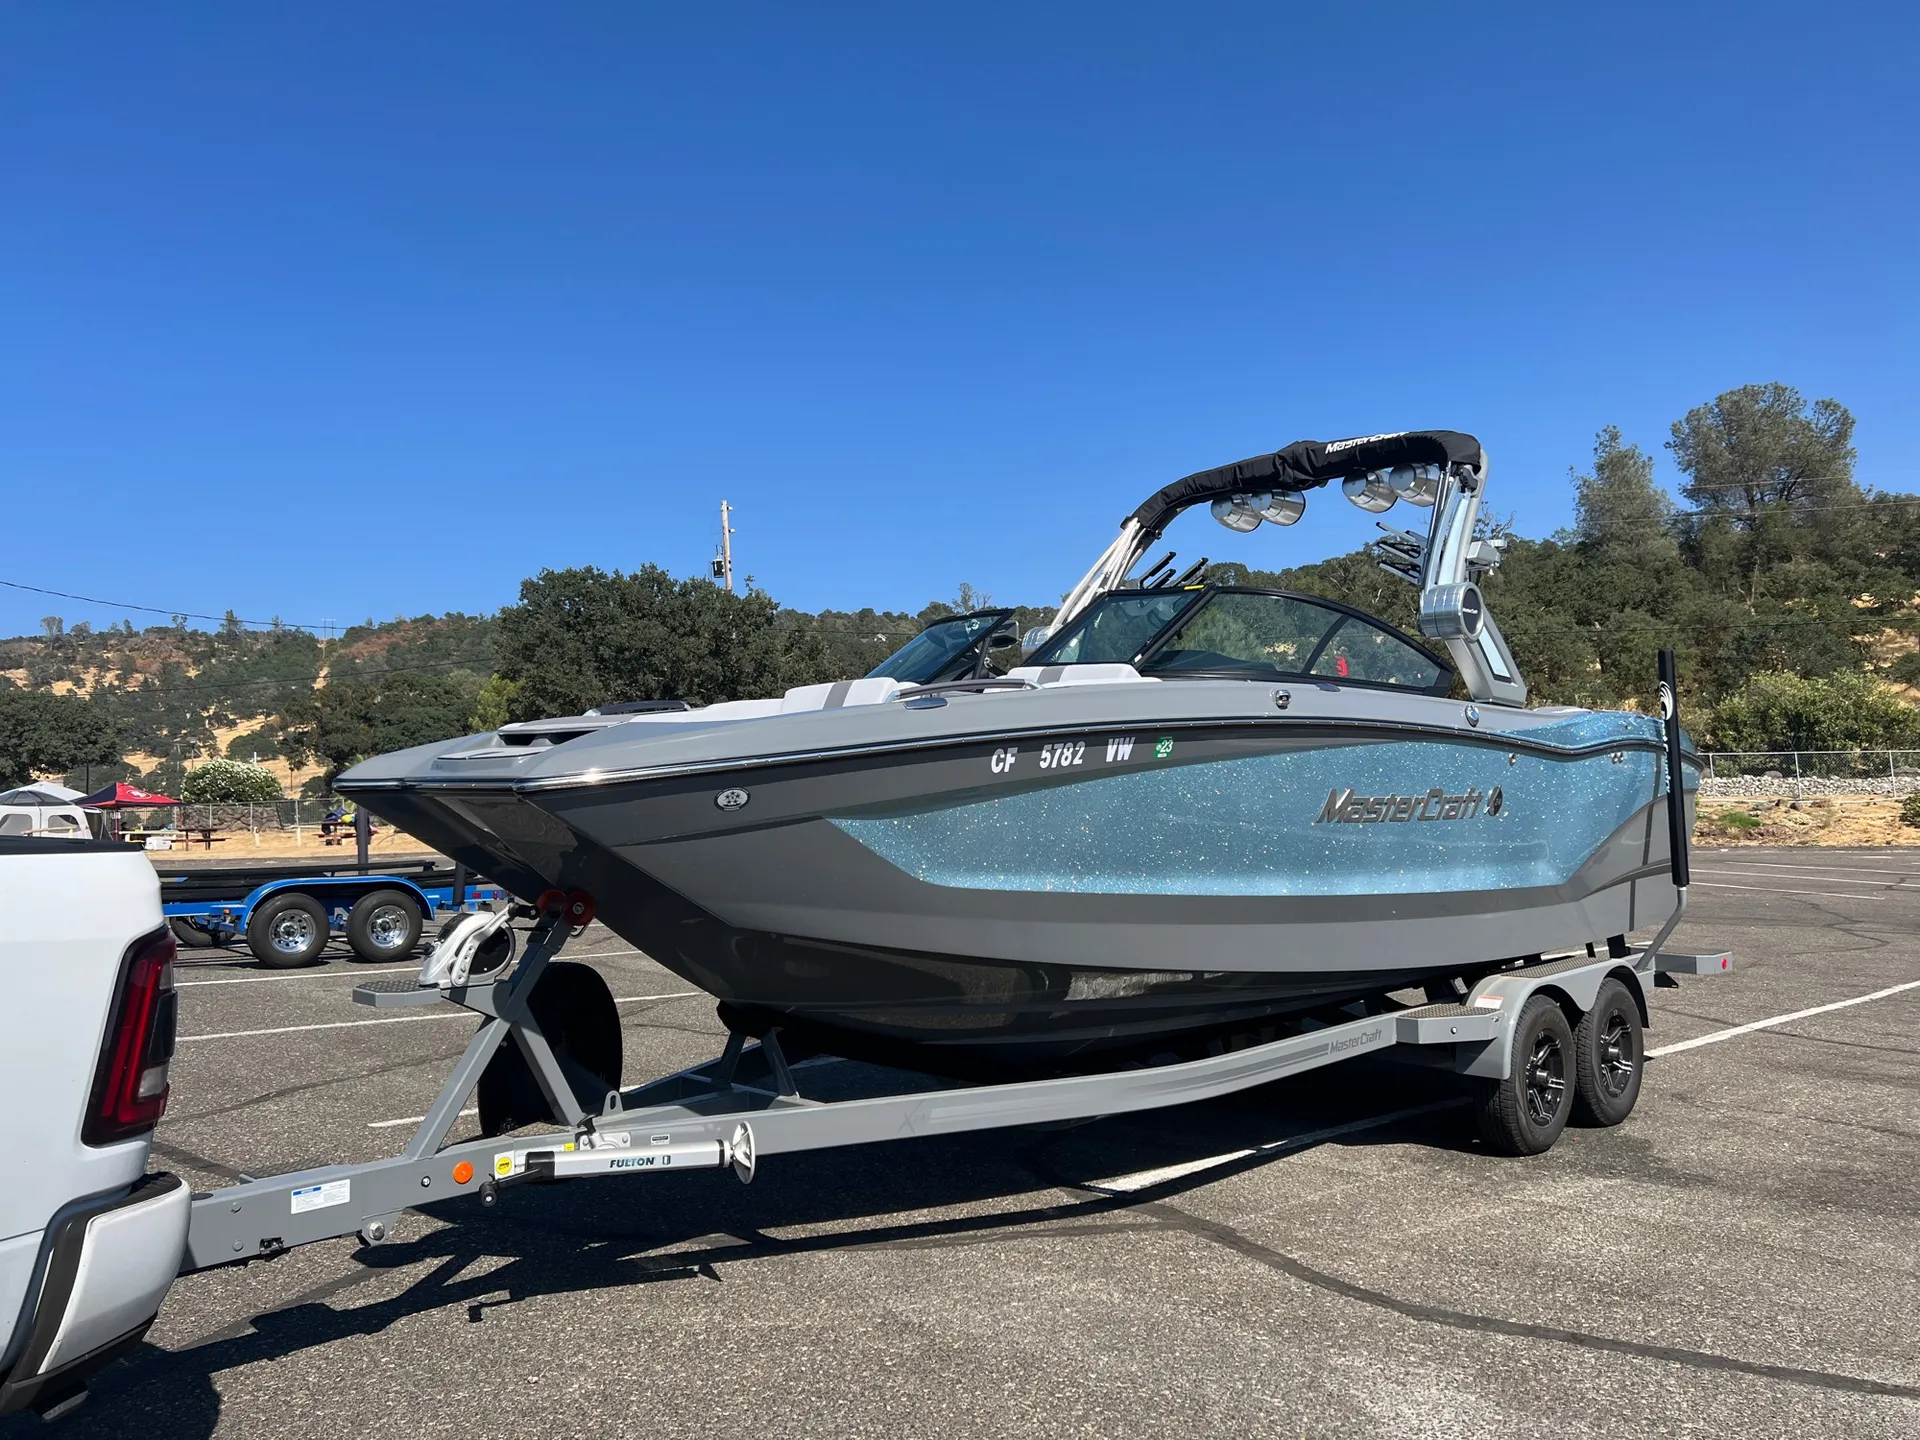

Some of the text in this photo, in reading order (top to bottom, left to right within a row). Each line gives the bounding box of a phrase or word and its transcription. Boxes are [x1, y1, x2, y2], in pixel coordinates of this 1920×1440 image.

[990, 737, 1135, 773] CF 5782 VW
[1160, 739, 1174, 753] 23
[1315, 787, 1485, 824] MasterCraft
[1329, 1028, 1382, 1055] MasterCraft
[609, 1156, 656, 1168] FULTON
